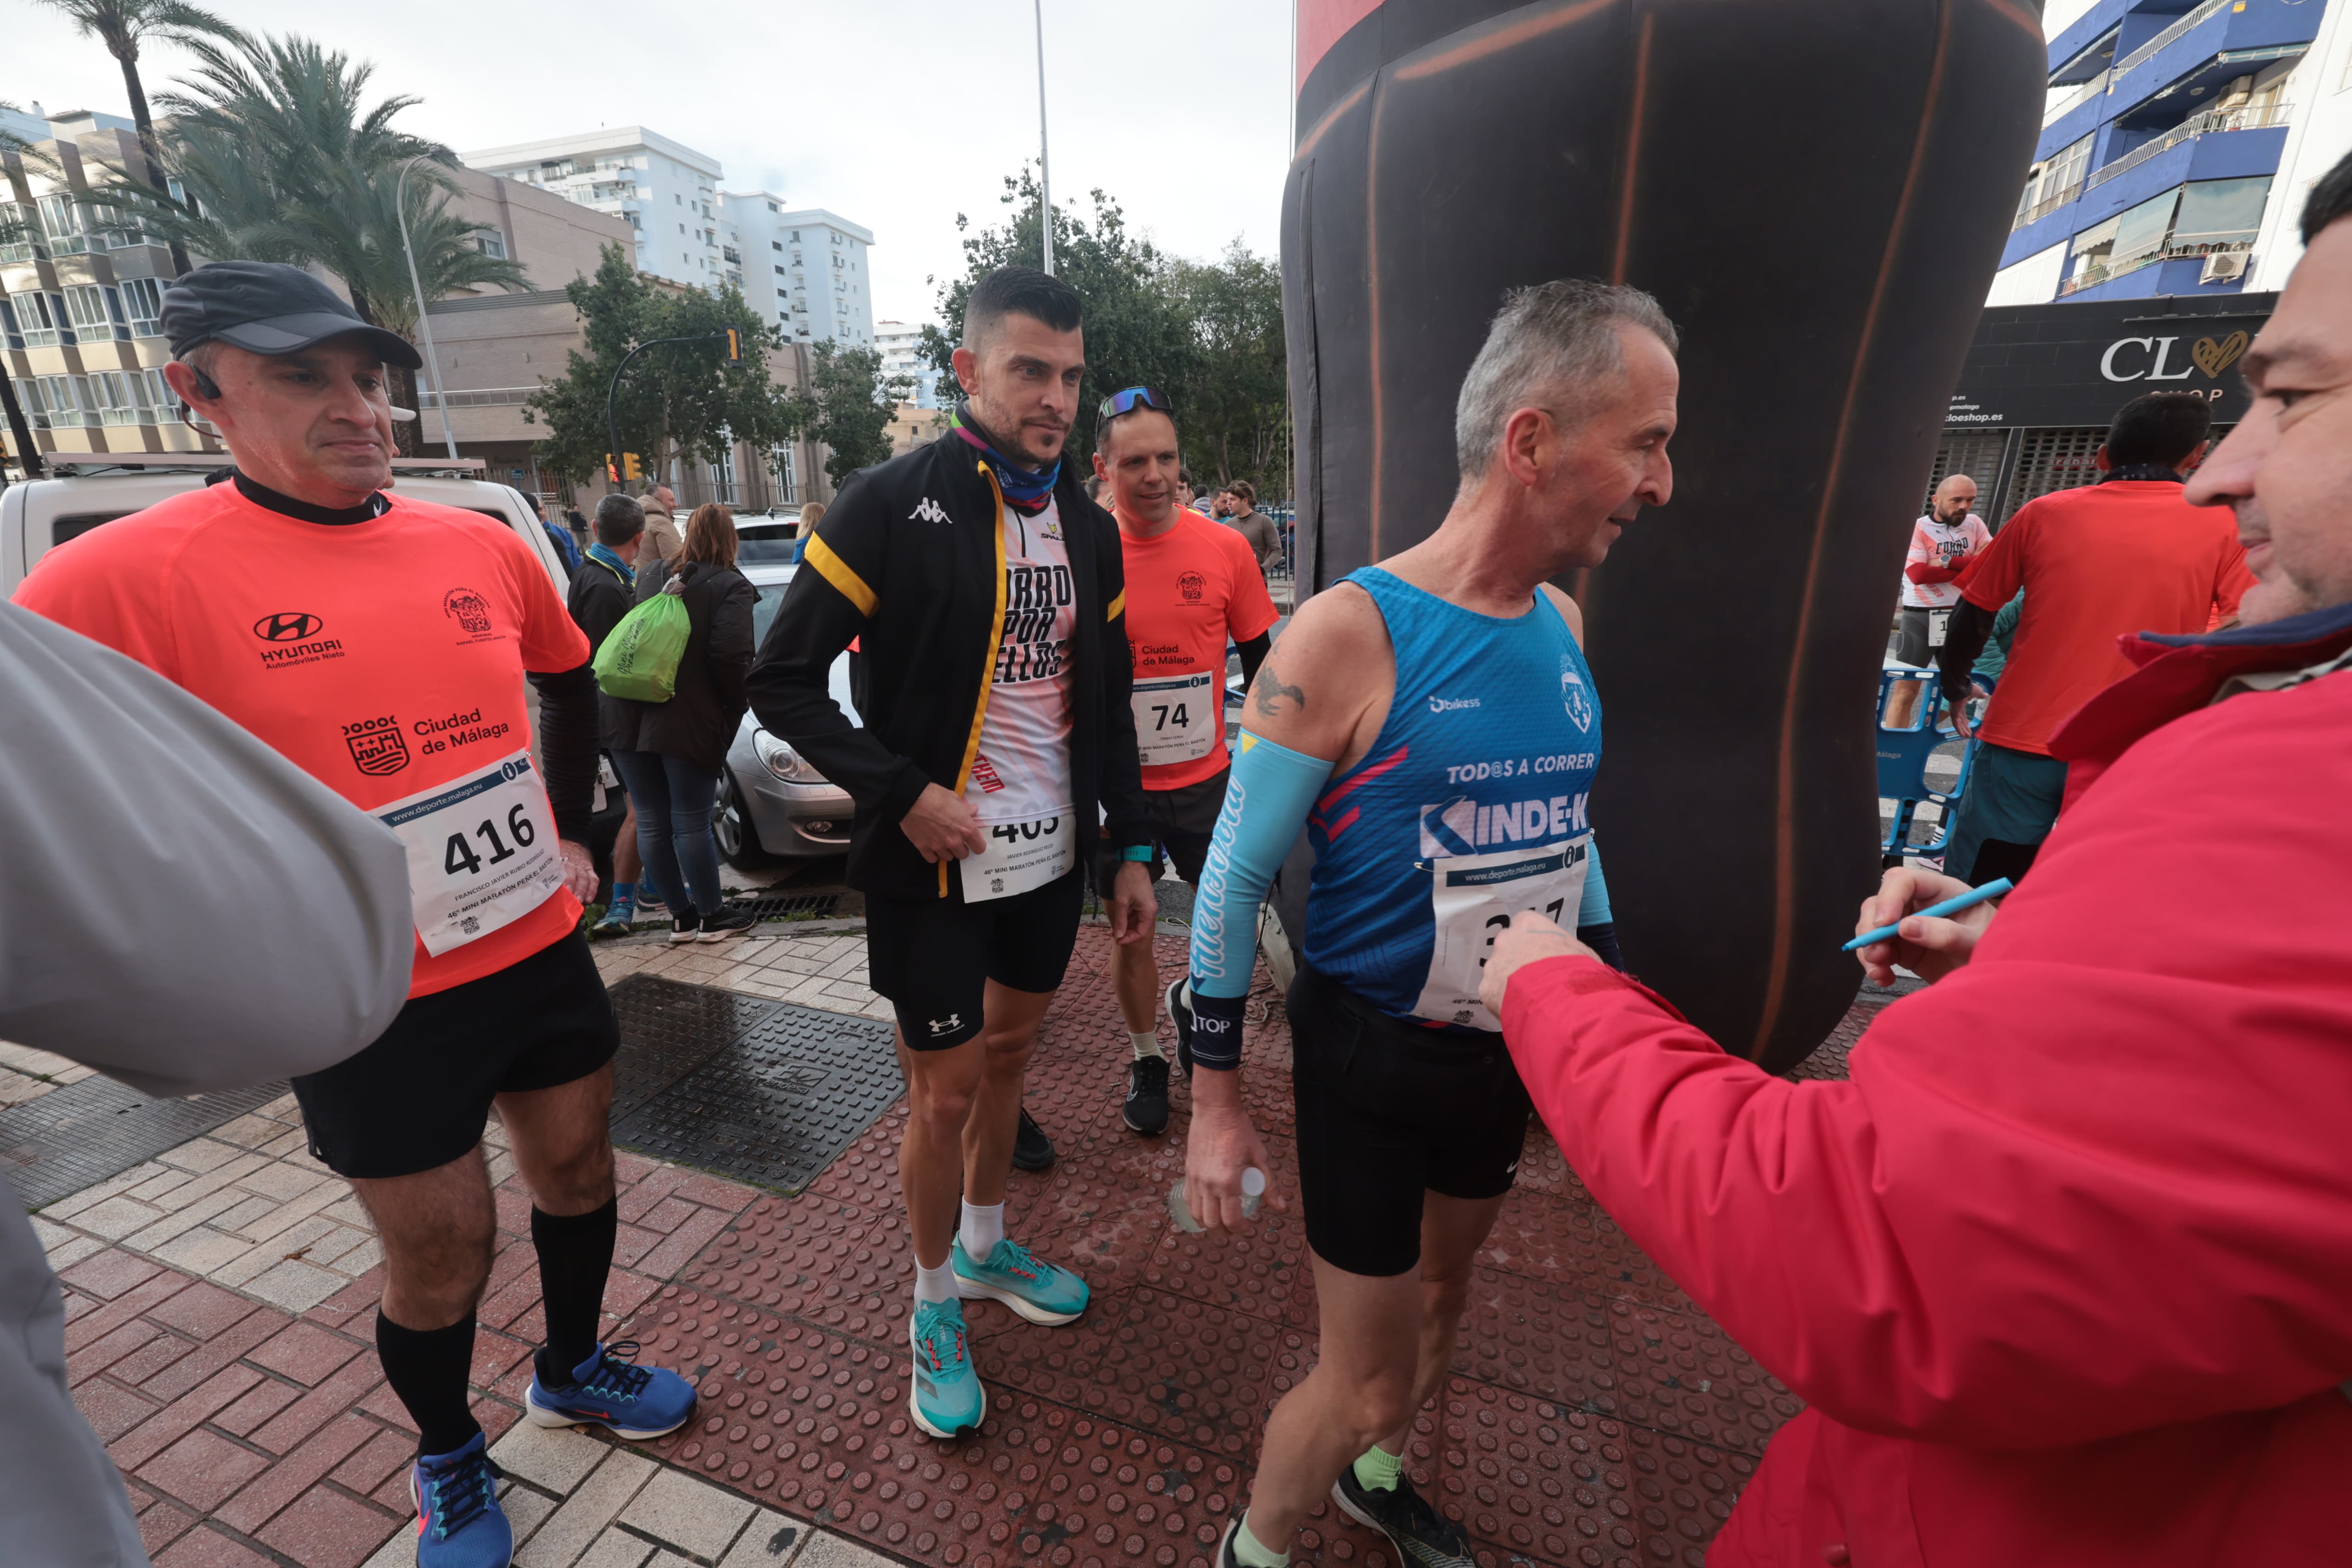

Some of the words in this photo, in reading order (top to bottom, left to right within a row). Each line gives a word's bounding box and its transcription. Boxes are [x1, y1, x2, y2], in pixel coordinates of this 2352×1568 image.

[1002, 607, 1057, 644] POR
[260, 640, 342, 662] HYUNDAI
[266, 656, 320, 670] Automóviles
[322, 651, 345, 660] Nieto
[1142, 645, 1179, 654] Ciudad
[1159, 656, 1194, 665] Málaga
[414, 708, 481, 736] Ciudad
[1152, 703, 1189, 731] 74
[422, 737, 446, 755] de
[452, 722, 509, 747] Málaga
[1447, 759, 1514, 784] TOD@S
[1517, 759, 1529, 776] A
[1534, 753, 1594, 774] CORRER
[392, 783, 483, 822] www.deporte.malaga.eu
[445, 803, 534, 875] 416
[1023, 847, 1043, 856] RODRÍGUEZ
[455, 883, 490, 901] FRANCISCO
[491, 872, 509, 885] JAVIER
[510, 863, 526, 874] RUBIO
[526, 849, 545, 866] RODRÍGUEZ
[1009, 861, 1035, 871] MARATÓN
[1035, 857, 1046, 866] PEÑA
[1465, 863, 1546, 881] www.deporte.malaga.eu
[462, 902, 479, 912] MINI
[481, 884, 515, 904] MARATÓN
[517, 874, 532, 887] PEÑA
[539, 856, 554, 872] BASTÓN
[1479, 897, 1564, 968] 37
[947, 1024, 965, 1034] ARMOUR
